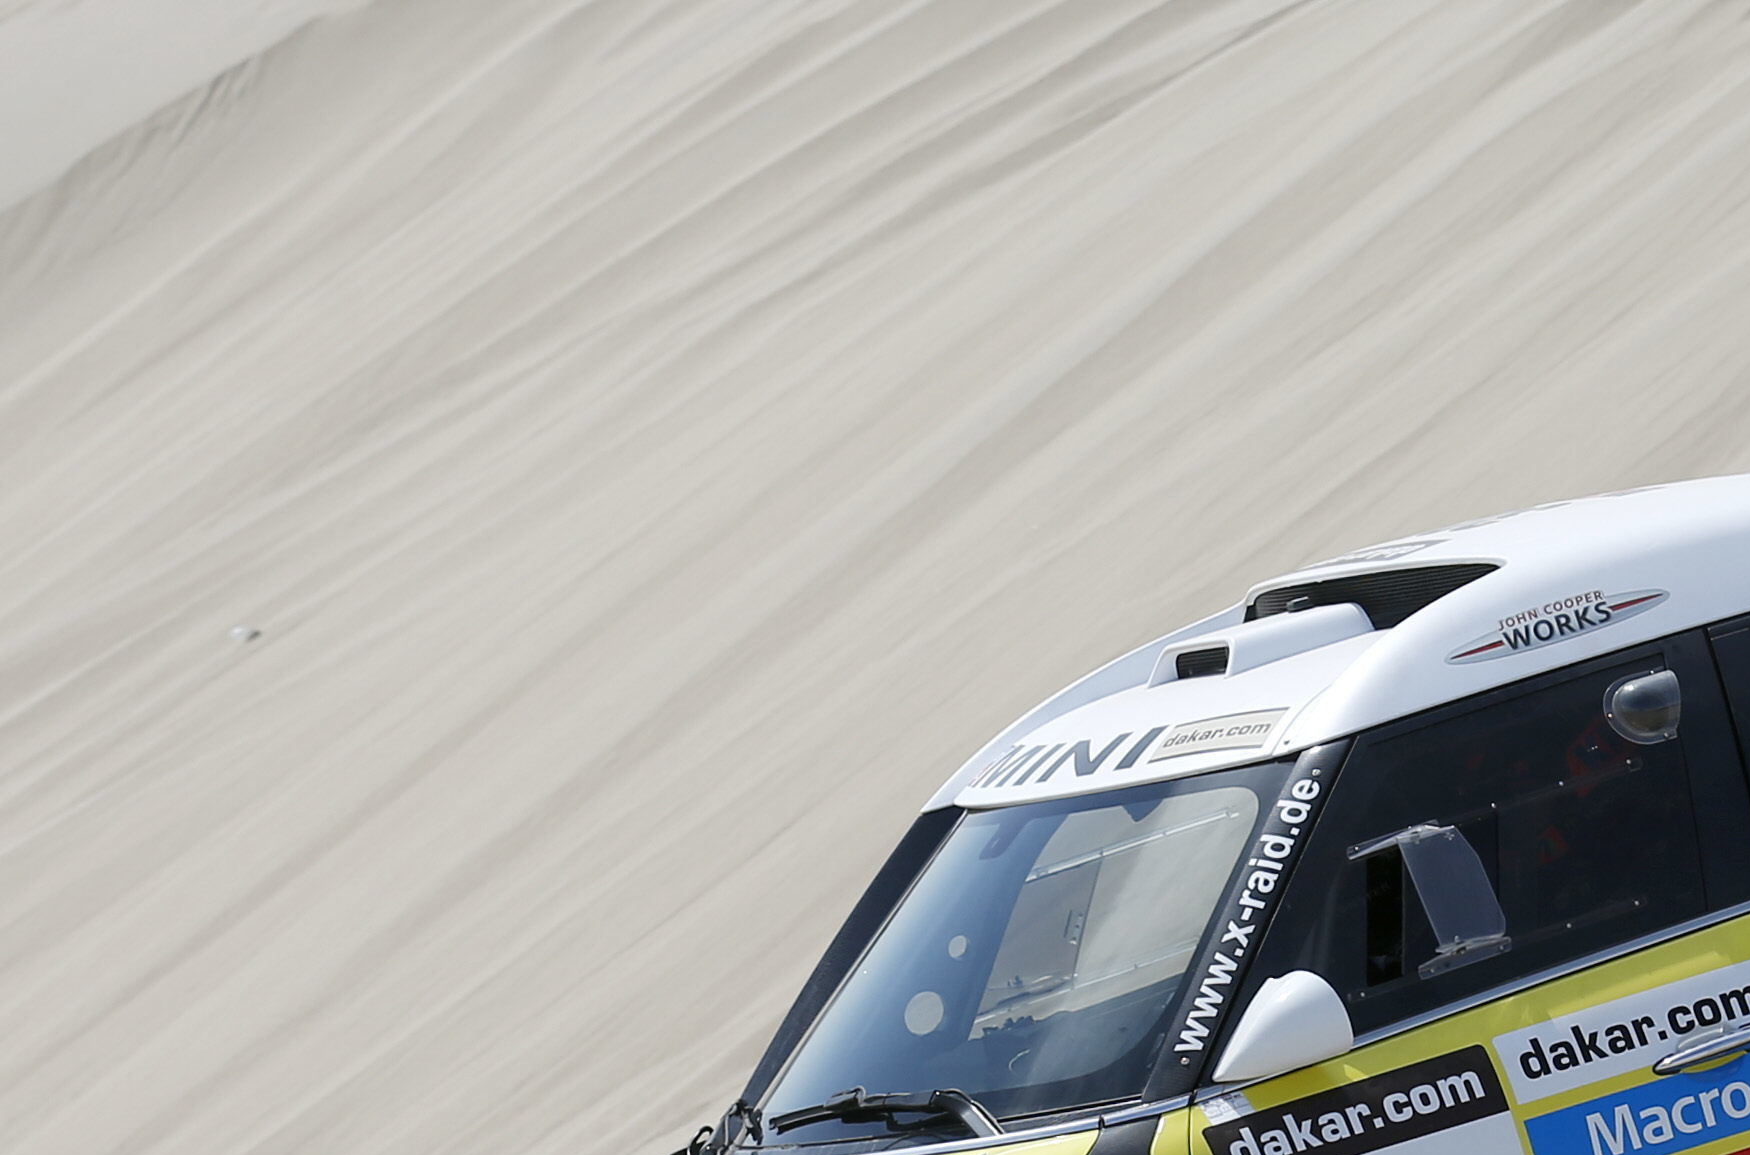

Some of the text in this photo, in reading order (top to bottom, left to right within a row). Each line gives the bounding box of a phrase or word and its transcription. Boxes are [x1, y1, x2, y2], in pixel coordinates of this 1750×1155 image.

[1499, 590, 1604, 631] JOHN COOPER
[1502, 601, 1612, 650] WORKS
[970, 721, 1272, 788] MINI dakar.com
[1174, 778, 1321, 1052] www.x-raid.de
